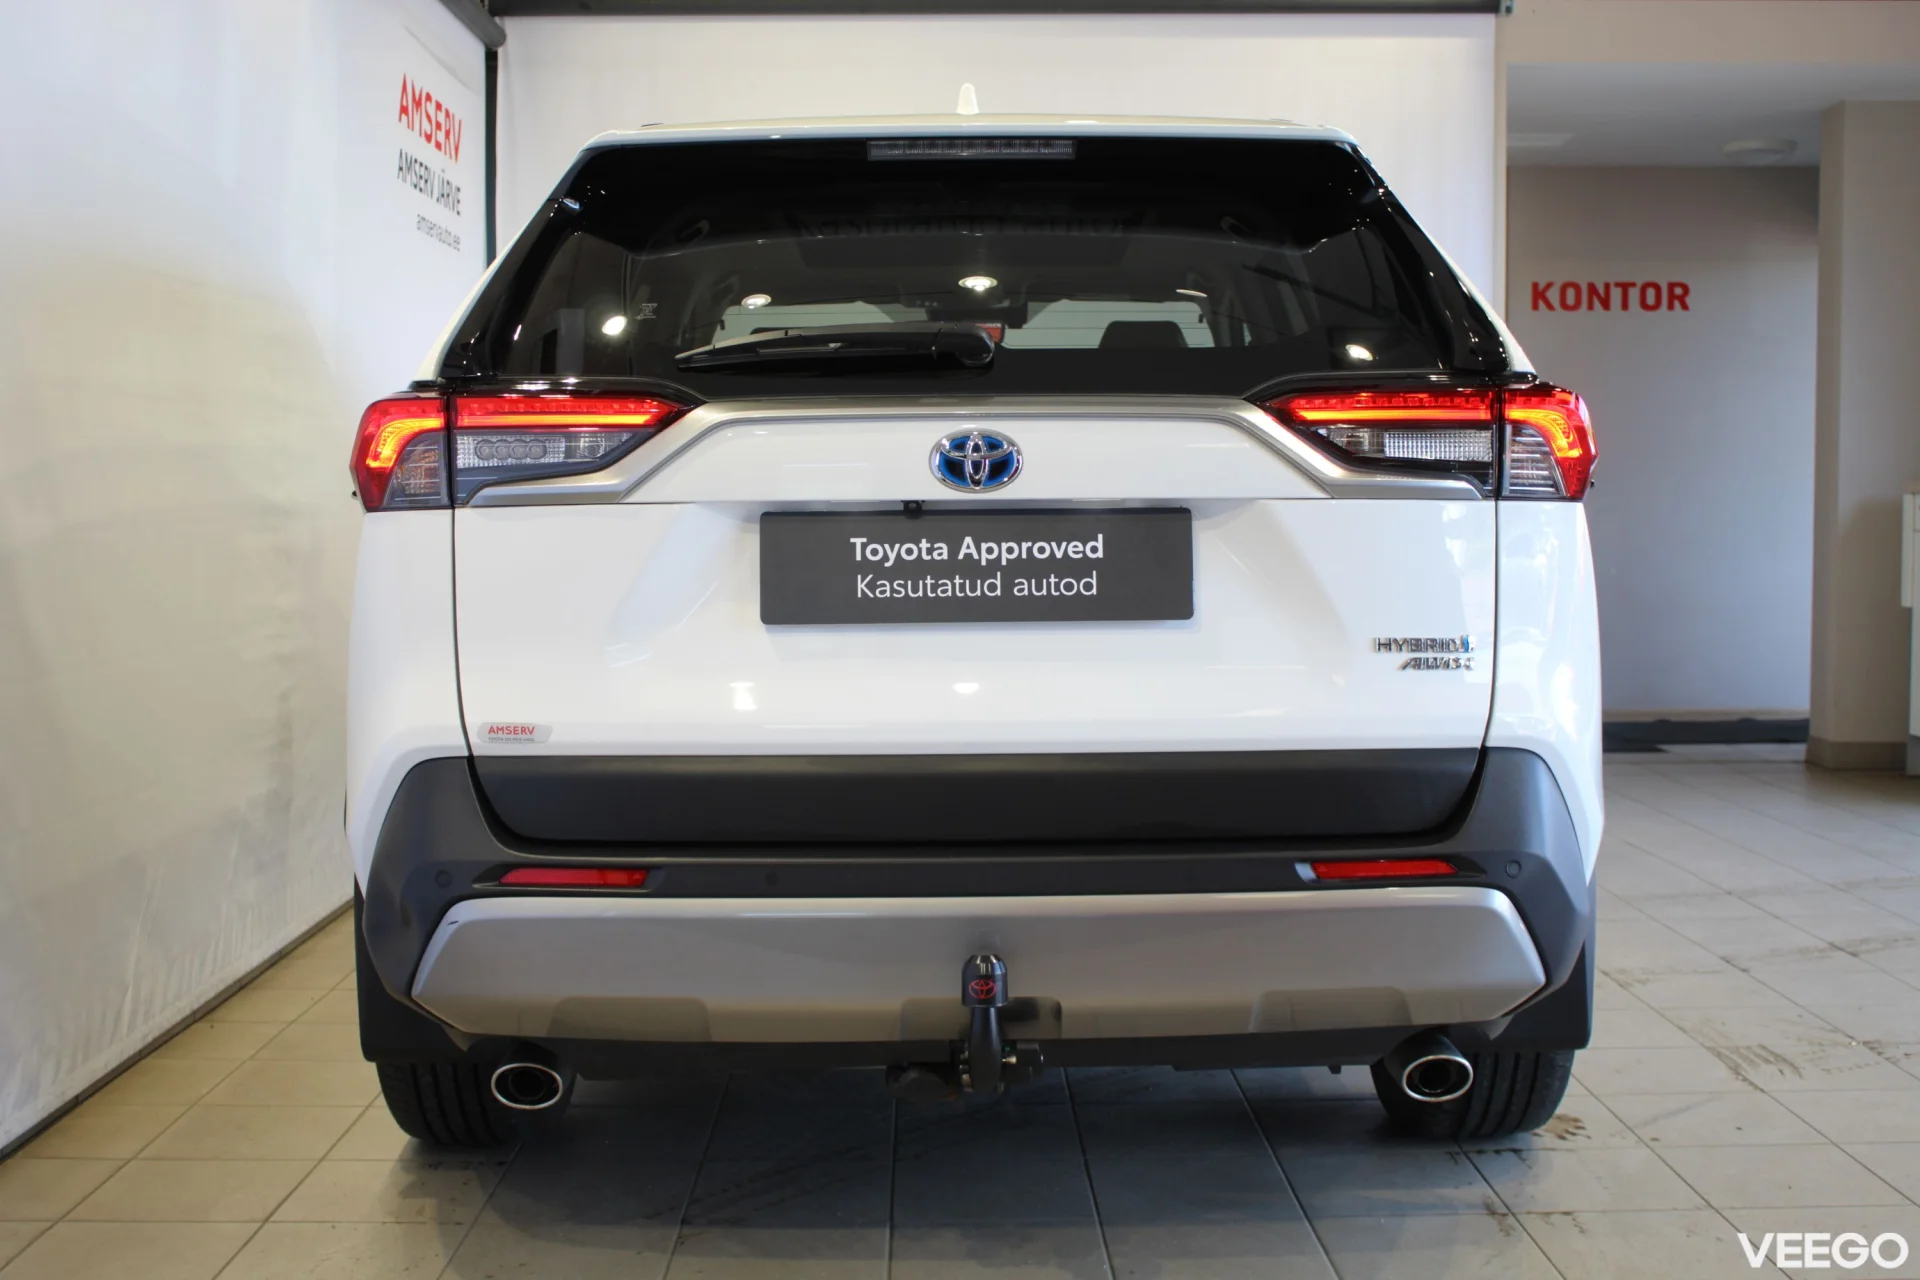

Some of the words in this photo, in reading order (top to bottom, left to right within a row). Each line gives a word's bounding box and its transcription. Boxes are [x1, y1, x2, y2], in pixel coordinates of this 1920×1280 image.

[398, 72, 462, 164] AMSERV
[397, 148, 435, 200] AMSERV
[436, 168, 461, 217] JÄRVE
[1531, 281, 1691, 312] KONTOR
[850, 537, 949, 567] Toyota
[958, 534, 1104, 566] Approved
[857, 572, 1001, 598] Kasutatud
[1013, 571, 1098, 596] autod
[1374, 637, 1461, 653] HYBRID
[488, 726, 535, 735] AMSERV
